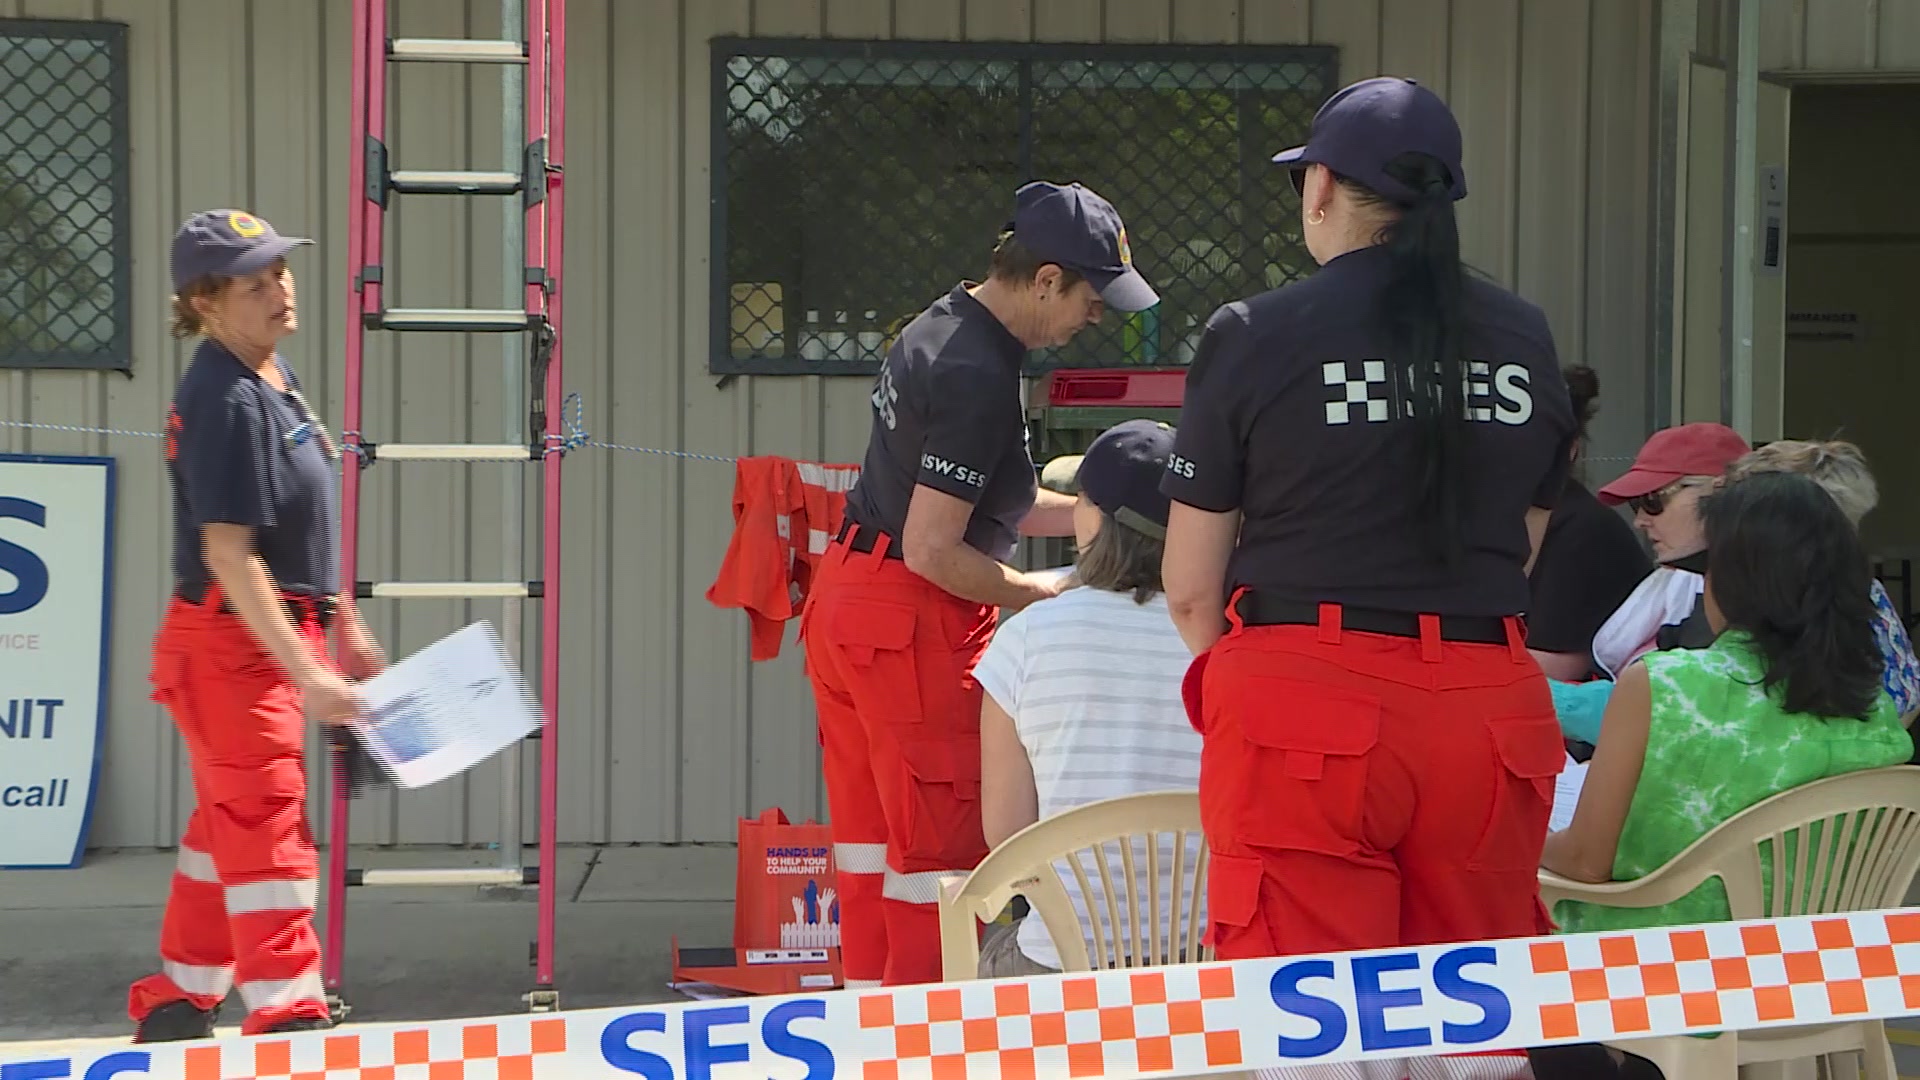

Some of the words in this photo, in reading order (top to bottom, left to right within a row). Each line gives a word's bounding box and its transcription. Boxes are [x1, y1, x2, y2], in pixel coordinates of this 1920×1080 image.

[1407, 361, 1534, 425] ES
[955, 466, 985, 487] SES
[1167, 453, 1195, 478] SES
[2, 779, 69, 807] call
[767, 848, 809, 857] HANDS
[812, 848, 827, 857] UP
[767, 866, 826, 874] COMMUNITY
[1270, 946, 1512, 1059] SES
